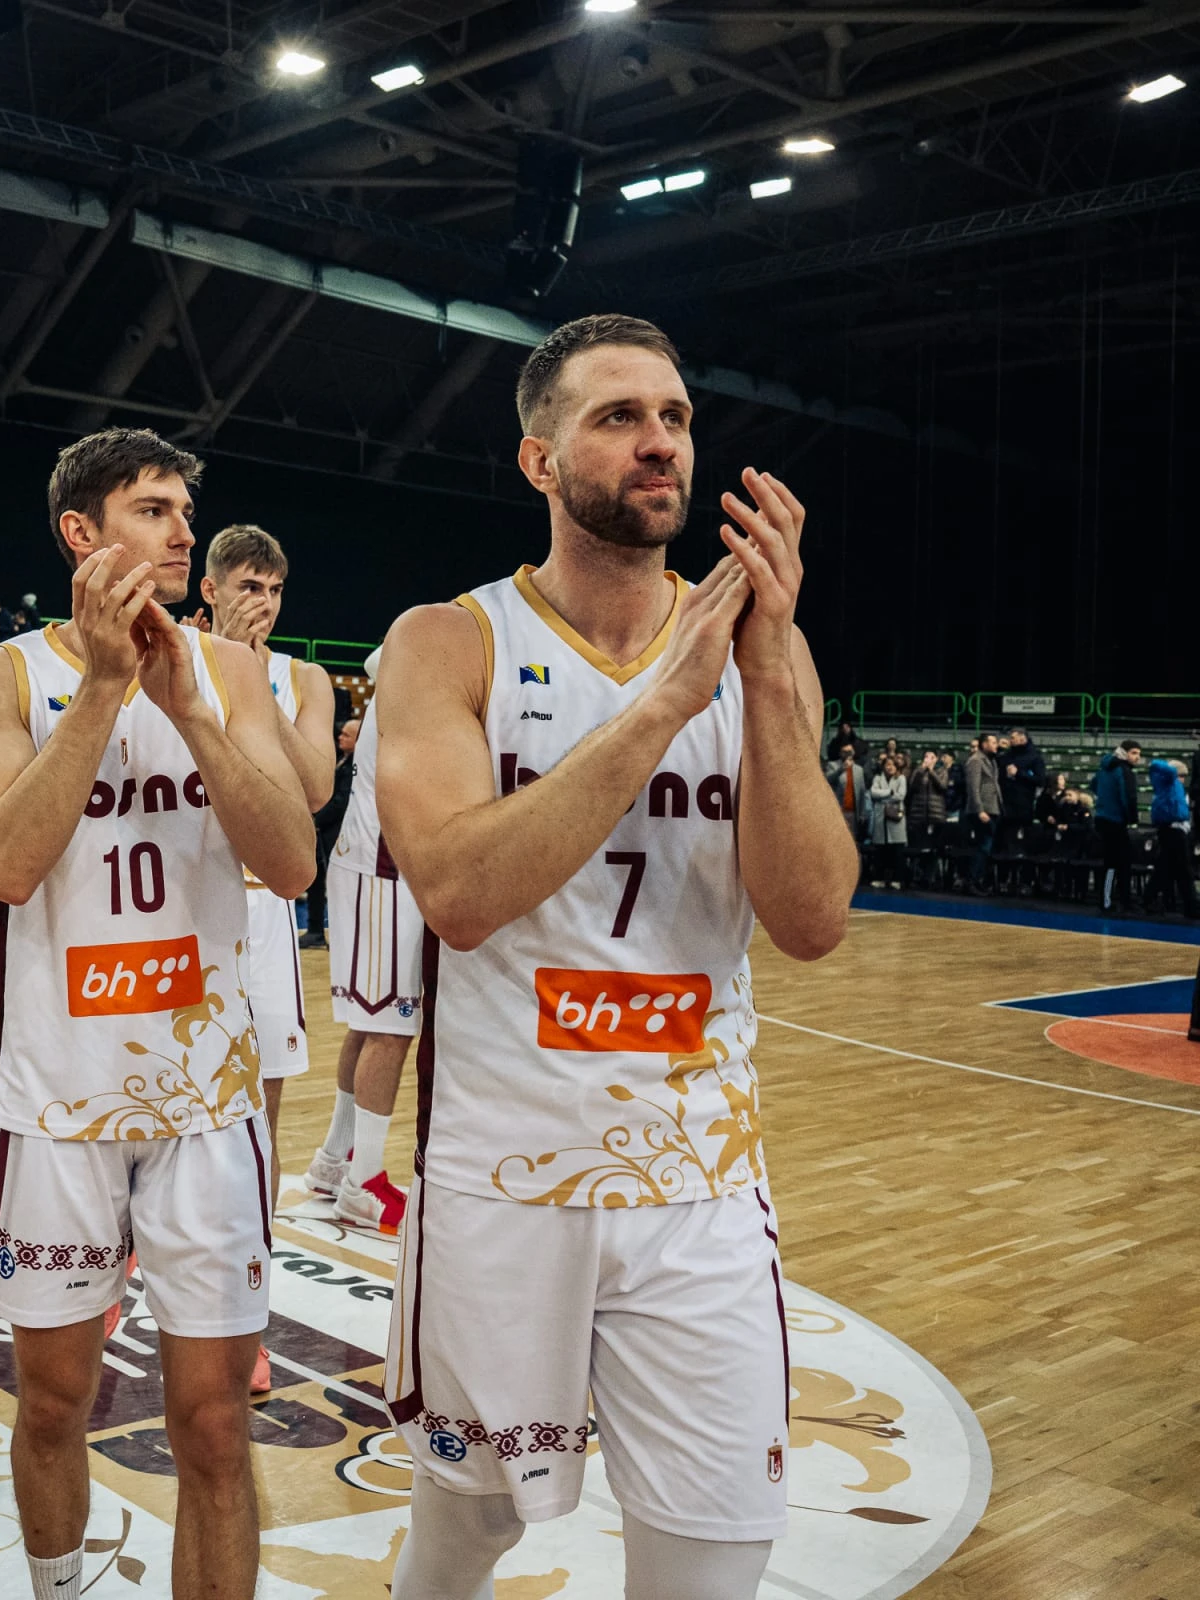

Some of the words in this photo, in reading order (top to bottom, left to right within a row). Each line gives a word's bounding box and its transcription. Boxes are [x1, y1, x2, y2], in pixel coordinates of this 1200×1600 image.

[530, 710, 552, 721] ARDU
[83, 770, 212, 819] osna
[103, 841, 165, 915] 10
[605, 851, 646, 938] 7
[81, 961, 137, 999] bh
[556, 991, 622, 1033] bh
[528, 1467, 550, 1479] ARDU
